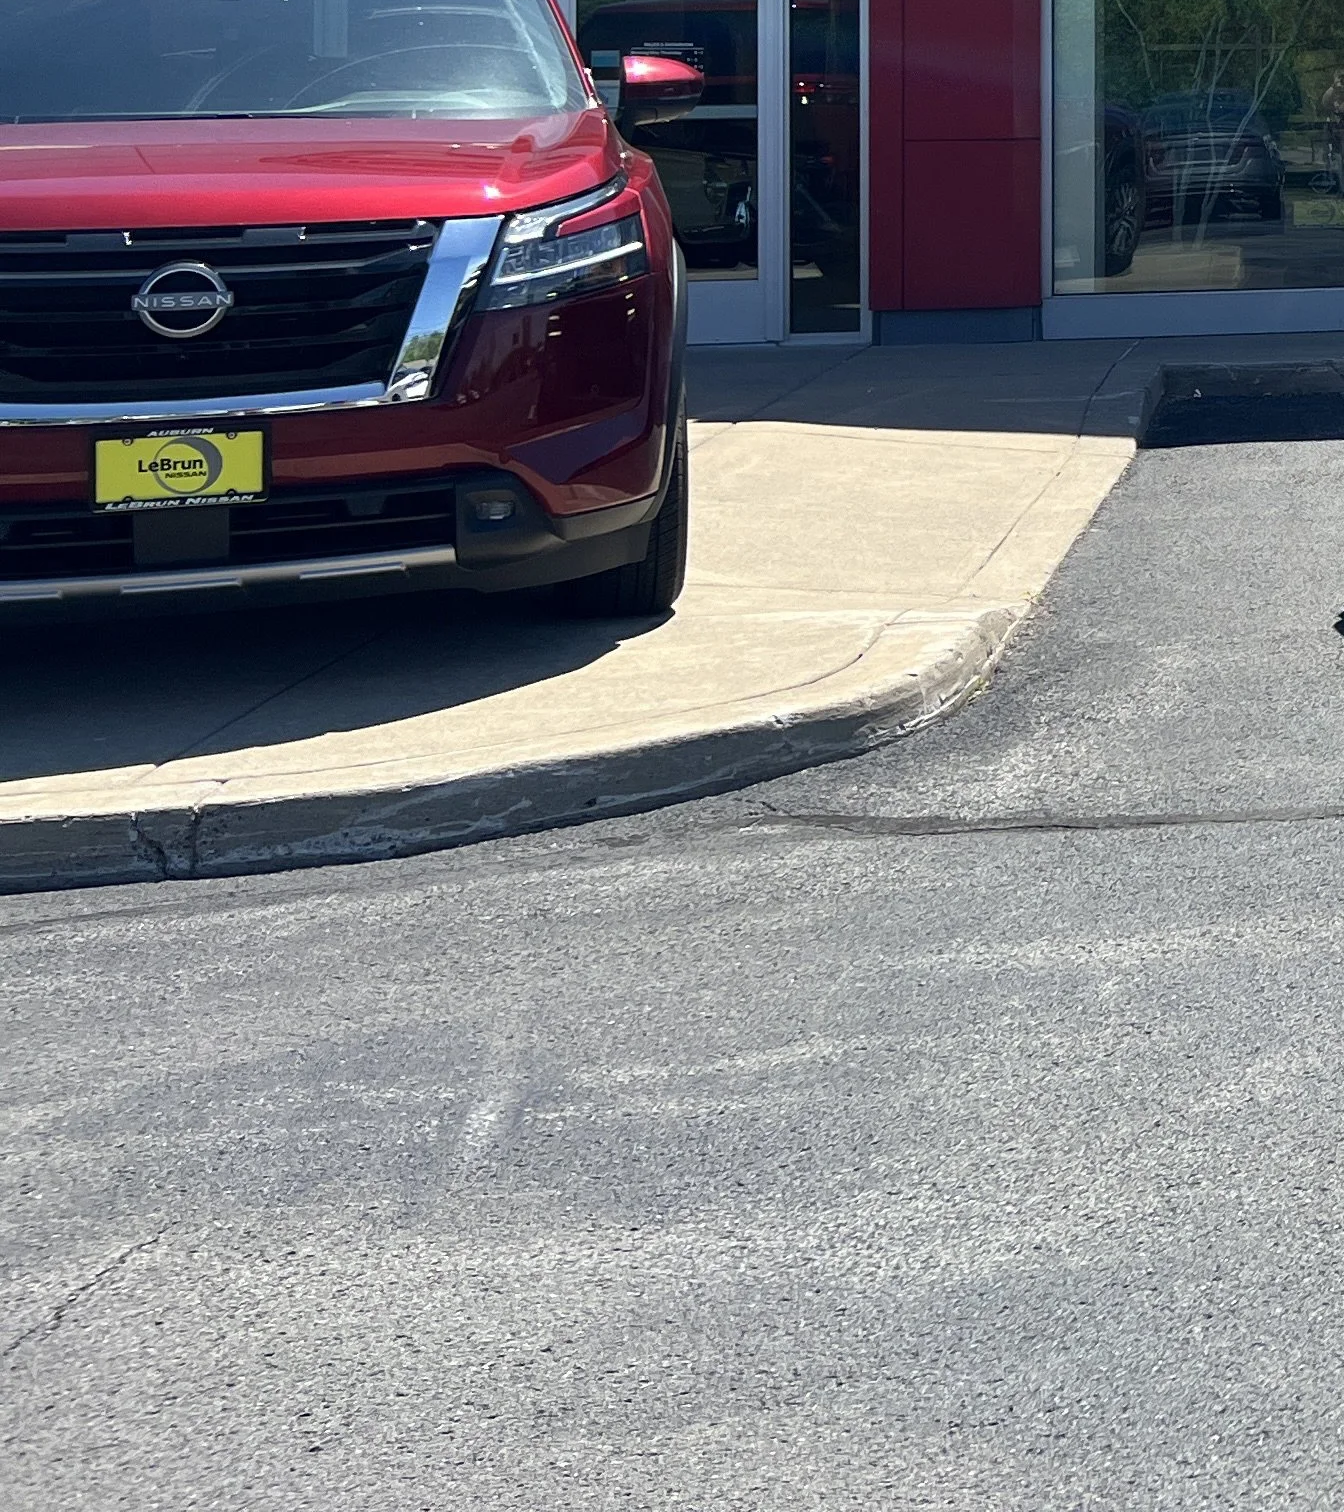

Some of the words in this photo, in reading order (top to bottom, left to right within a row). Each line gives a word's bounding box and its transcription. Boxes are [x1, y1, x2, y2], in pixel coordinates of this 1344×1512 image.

[133, 294, 232, 308] NISSAN
[147, 427, 214, 438] AUBURN
[138, 458, 204, 473] LeBrun
[164, 470, 207, 479] NISSAN
